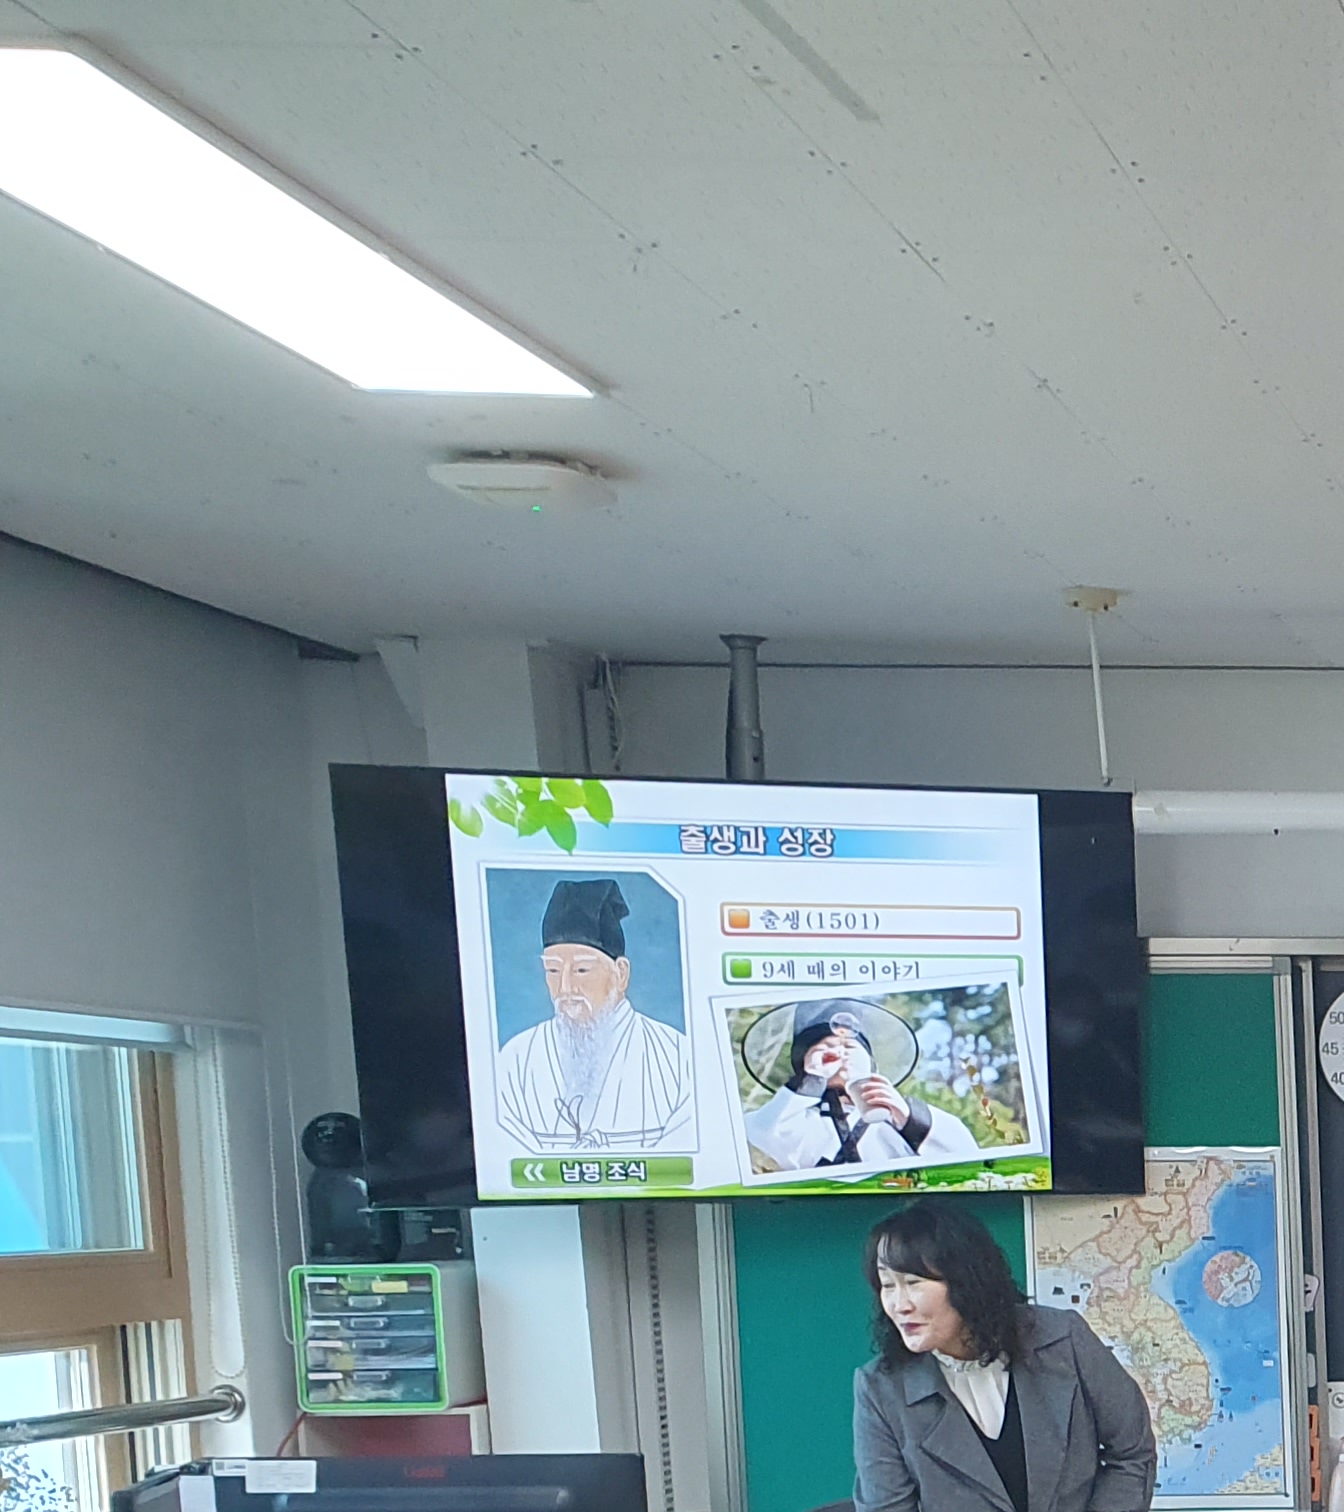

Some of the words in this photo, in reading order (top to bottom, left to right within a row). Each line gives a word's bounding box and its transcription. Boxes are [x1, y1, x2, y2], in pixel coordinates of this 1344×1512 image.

[679, 824, 767, 856] 출생과
[778, 826, 836, 857] 성장
[759, 909, 880, 931] 출생(1501)
[762, 960, 795, 980] 9세
[807, 960, 847, 981] 때의
[859, 960, 920, 981] 이야기
[1321, 1042, 1339, 1055] 45
[561, 1160, 602, 1183] 남명
[606, 1160, 647, 1182] 조식
